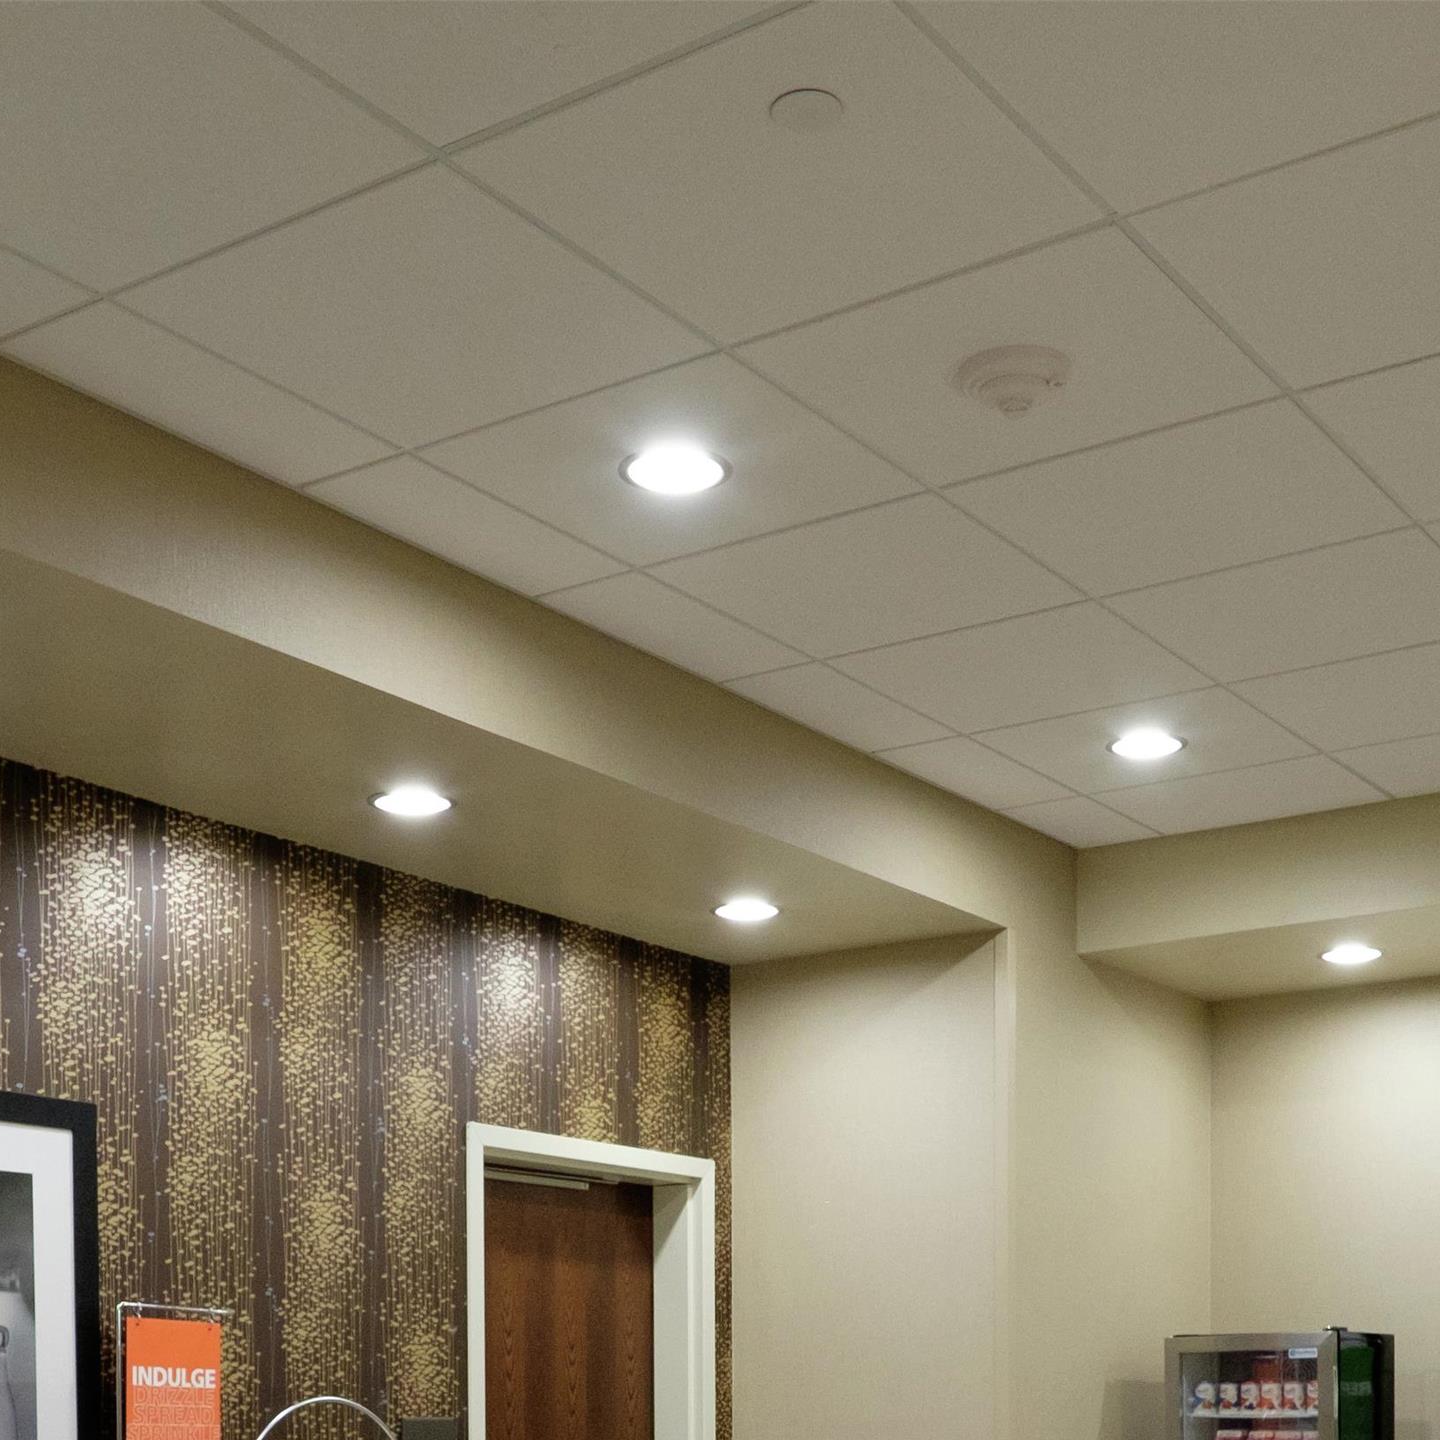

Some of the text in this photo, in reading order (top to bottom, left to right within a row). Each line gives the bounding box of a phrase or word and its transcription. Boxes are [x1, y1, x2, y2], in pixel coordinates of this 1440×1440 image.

[131, 1365, 217, 1389] INDULGE
[133, 1387, 215, 1408] DRIZZLE
[133, 1404, 215, 1426] SPREAD
